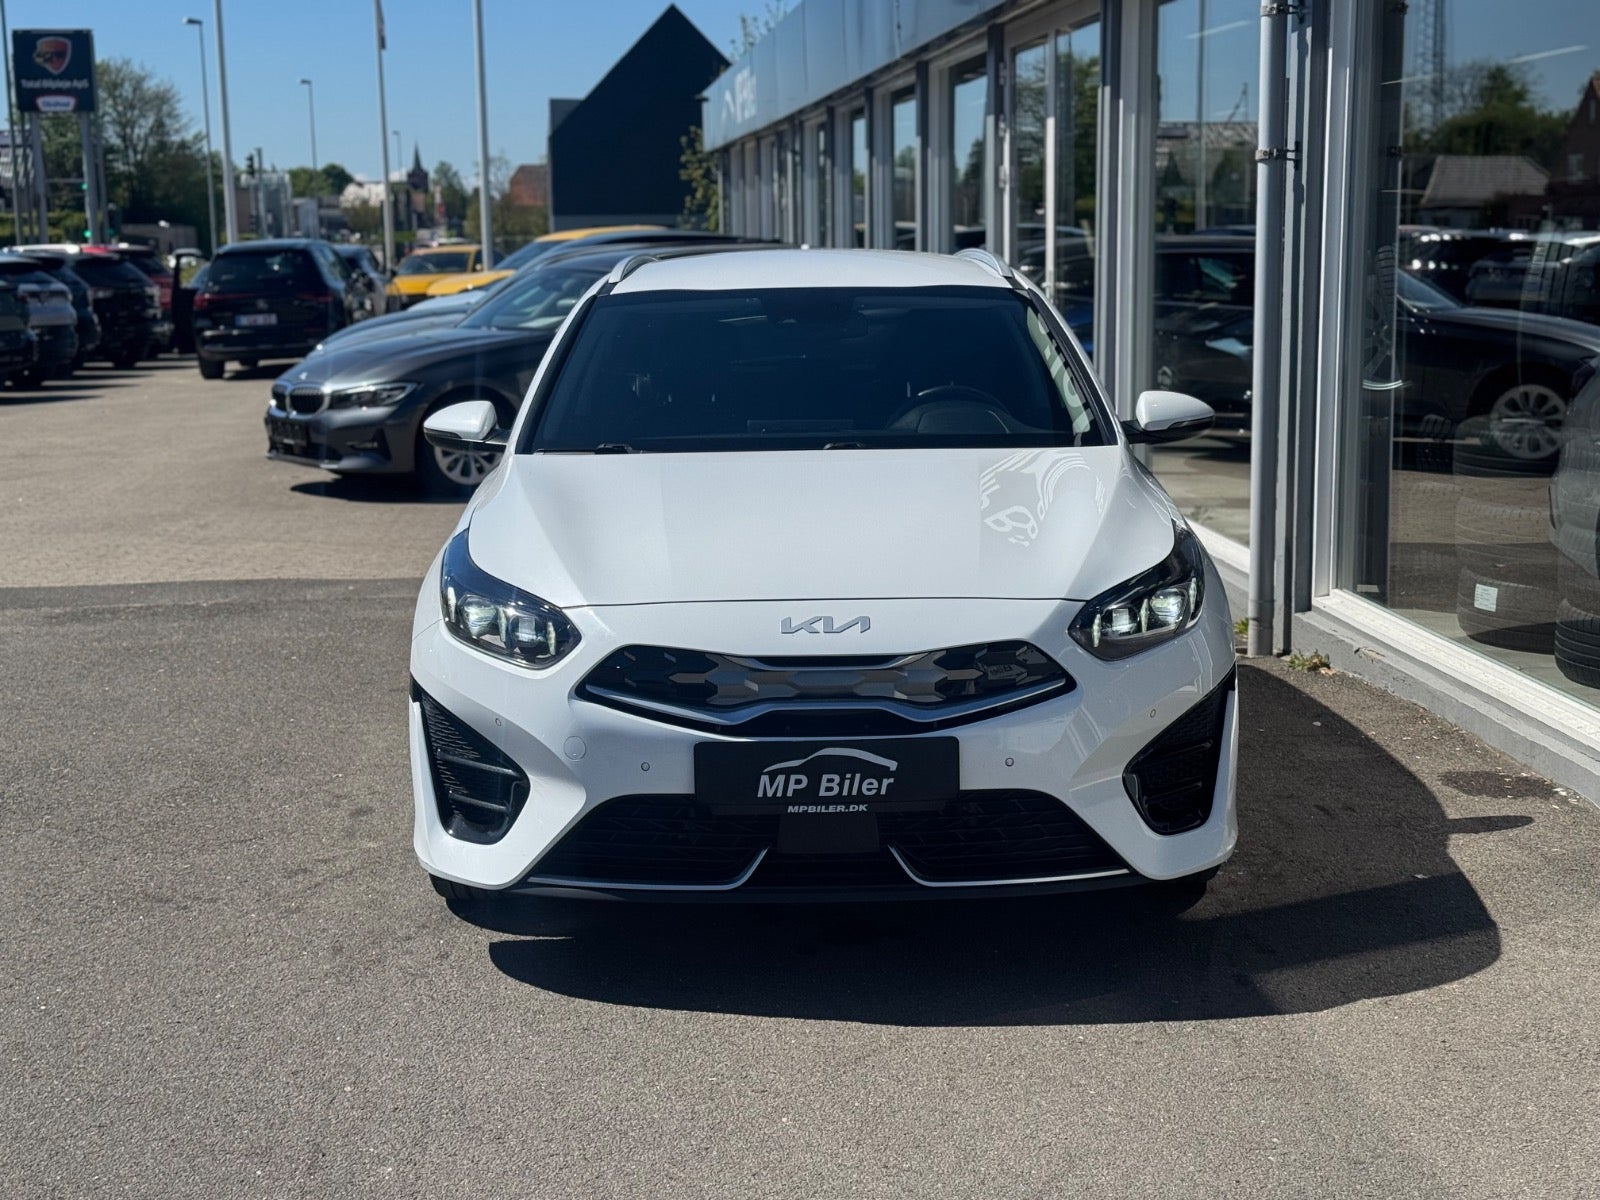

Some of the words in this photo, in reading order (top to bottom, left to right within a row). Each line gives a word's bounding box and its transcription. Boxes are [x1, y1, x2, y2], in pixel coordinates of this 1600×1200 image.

[780, 615, 871, 634] KIA
[757, 774, 808, 797] MP
[818, 773, 895, 797] Biler
[787, 803, 868, 813] MPBILER.DK
